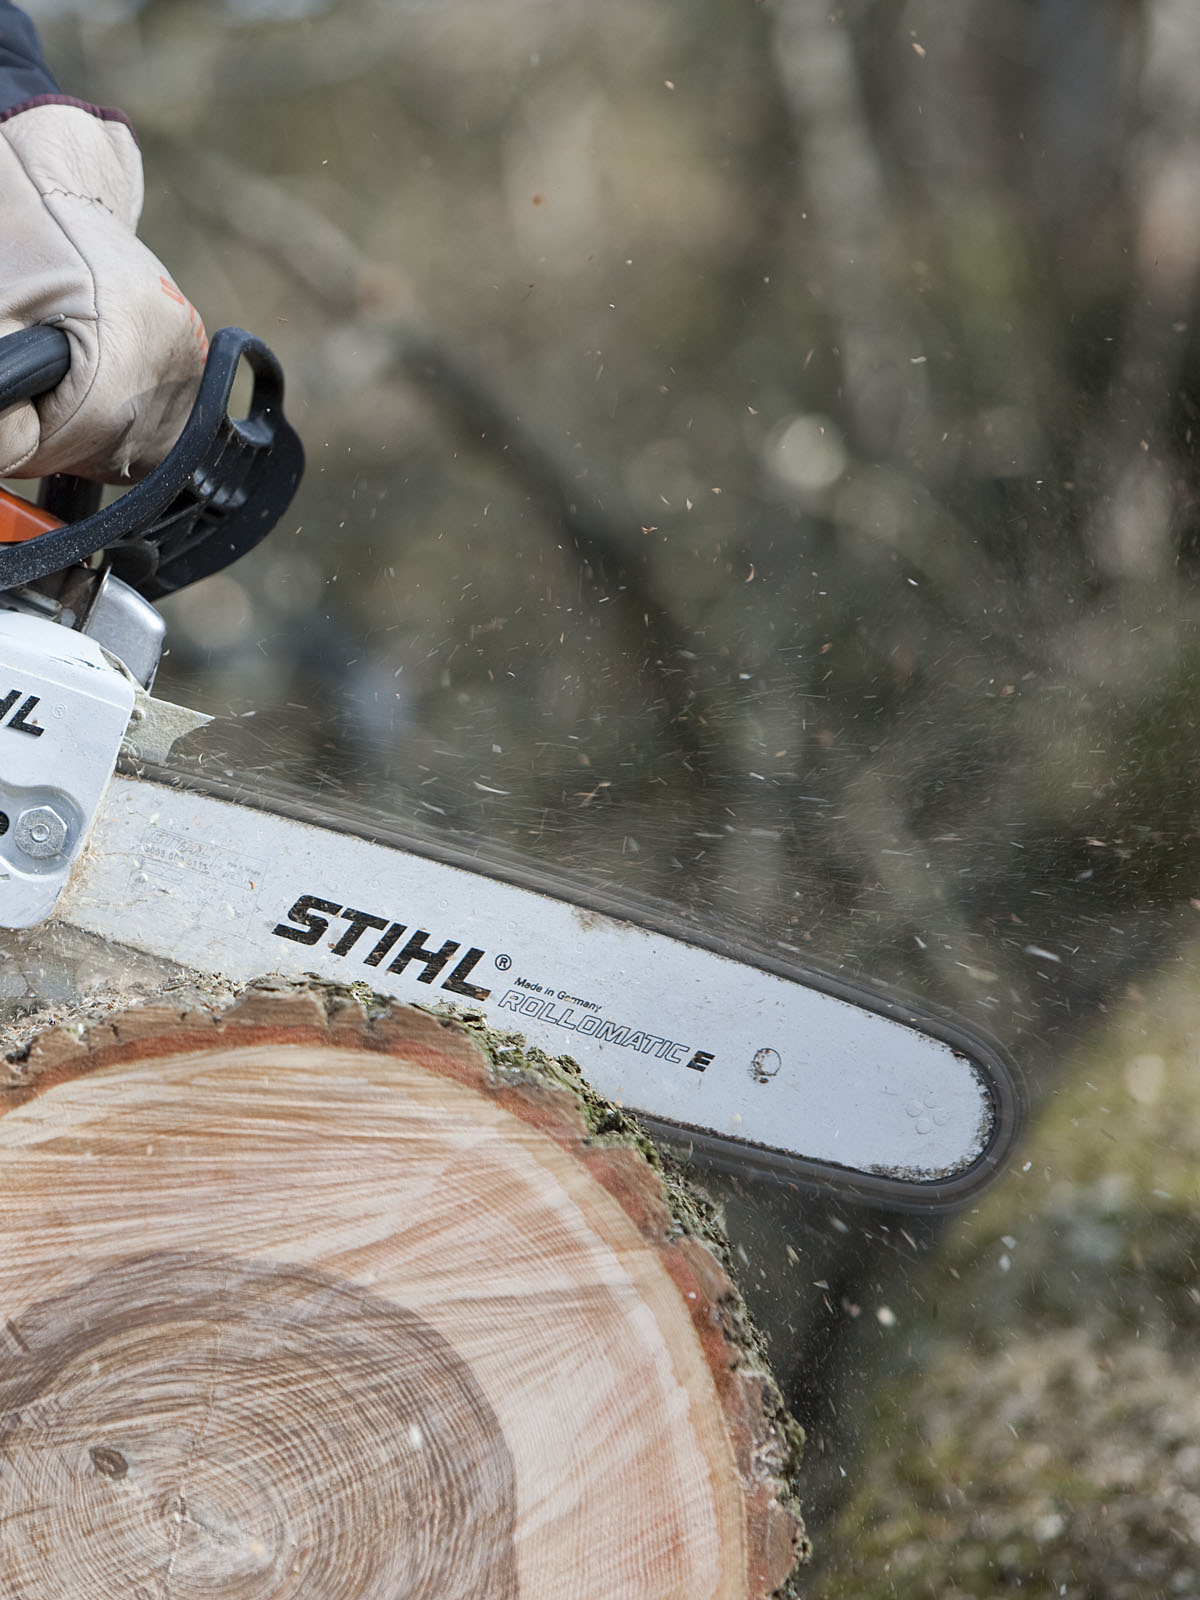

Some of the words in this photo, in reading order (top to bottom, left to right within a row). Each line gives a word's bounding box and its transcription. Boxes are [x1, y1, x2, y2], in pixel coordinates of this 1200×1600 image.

[513, 977, 543, 993] Made
[543, 986, 555, 997] in
[497, 989, 691, 1064] ROLLOMATIC
[686, 1050, 716, 1073] E
